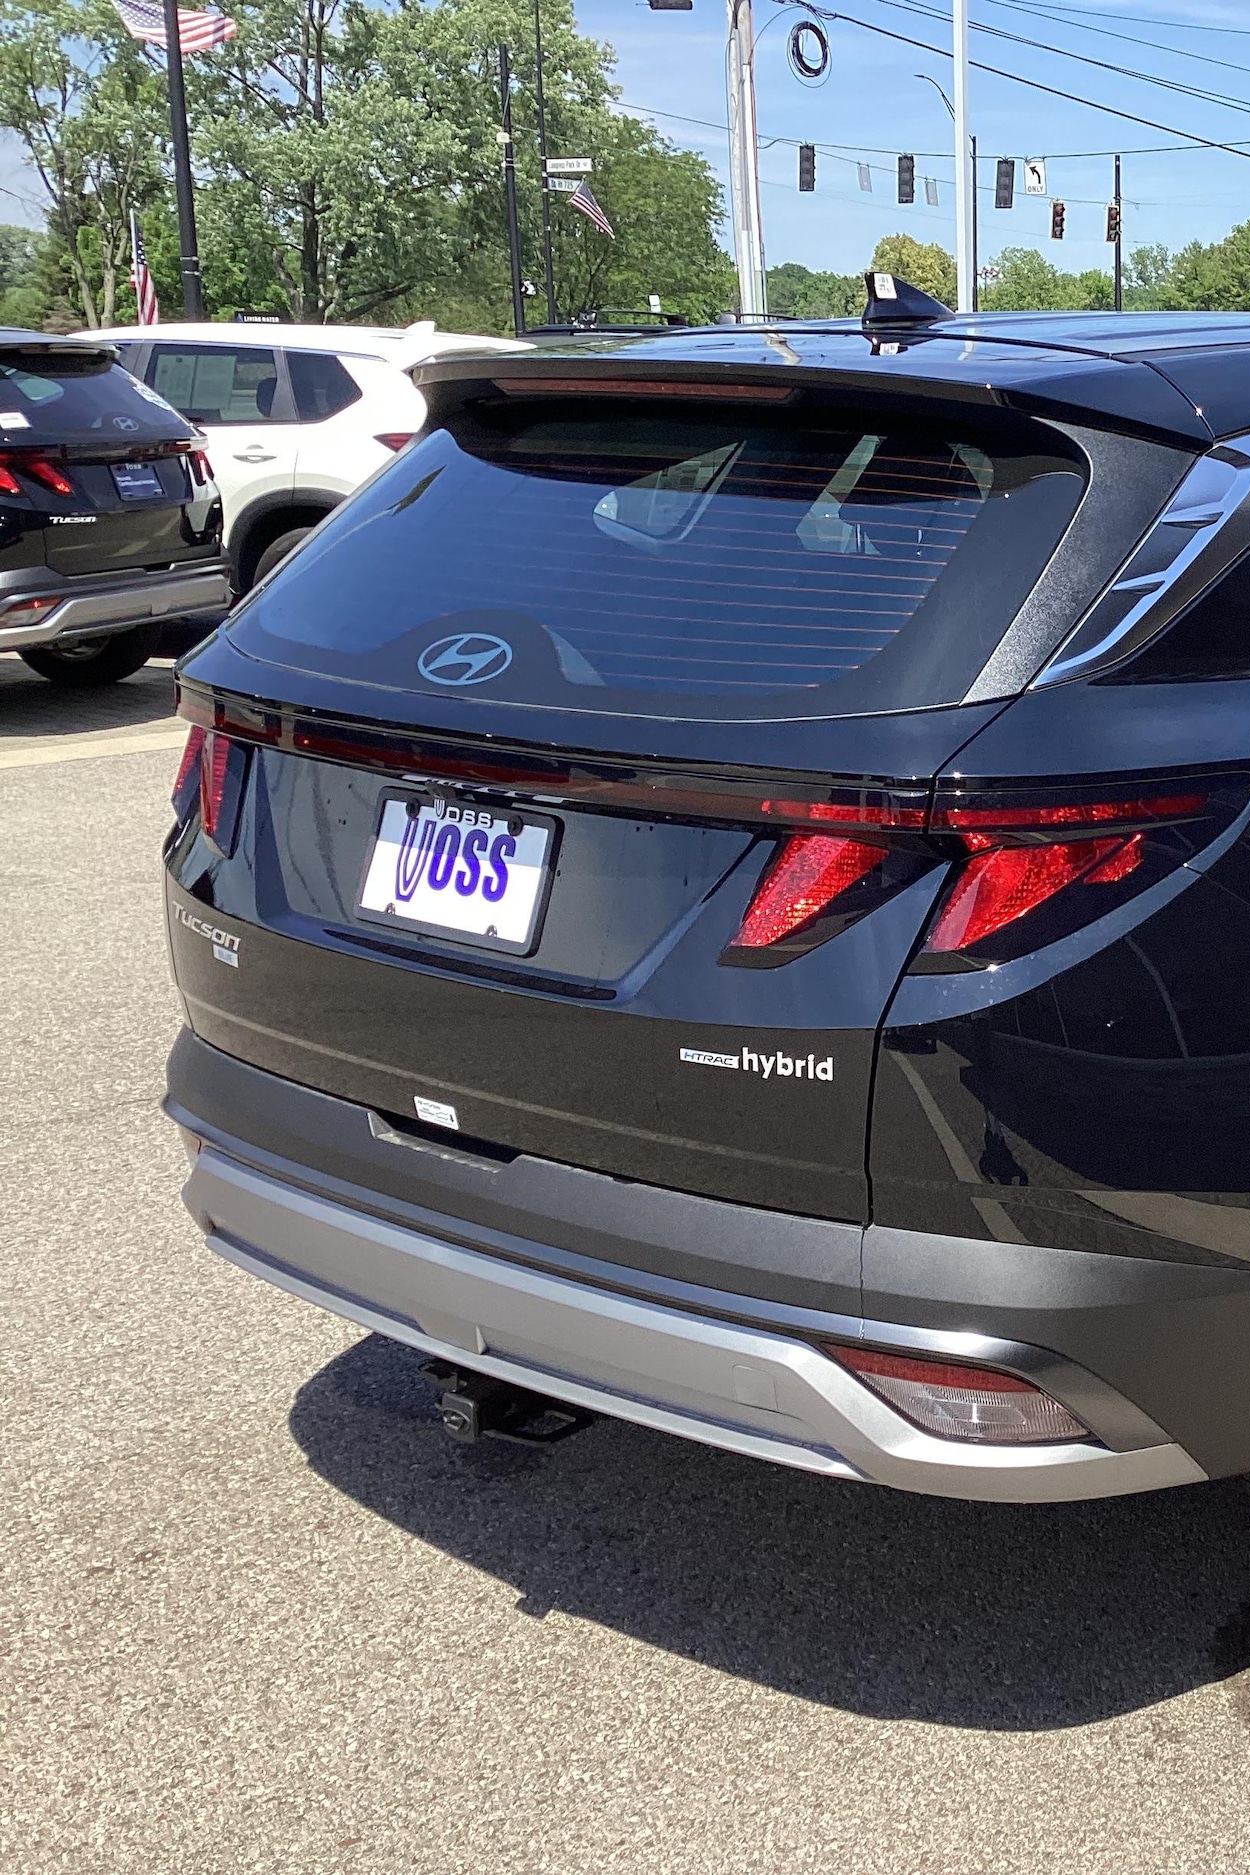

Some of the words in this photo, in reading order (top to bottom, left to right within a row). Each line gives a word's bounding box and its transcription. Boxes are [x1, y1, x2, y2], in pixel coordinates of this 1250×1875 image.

[566, 160, 575, 168] Park
[1027, 185, 1044, 193] ONLY
[395, 817, 517, 903] VOSS
[684, 1051, 734, 1066] HTRAC
[742, 1046, 834, 1082] hybrid
